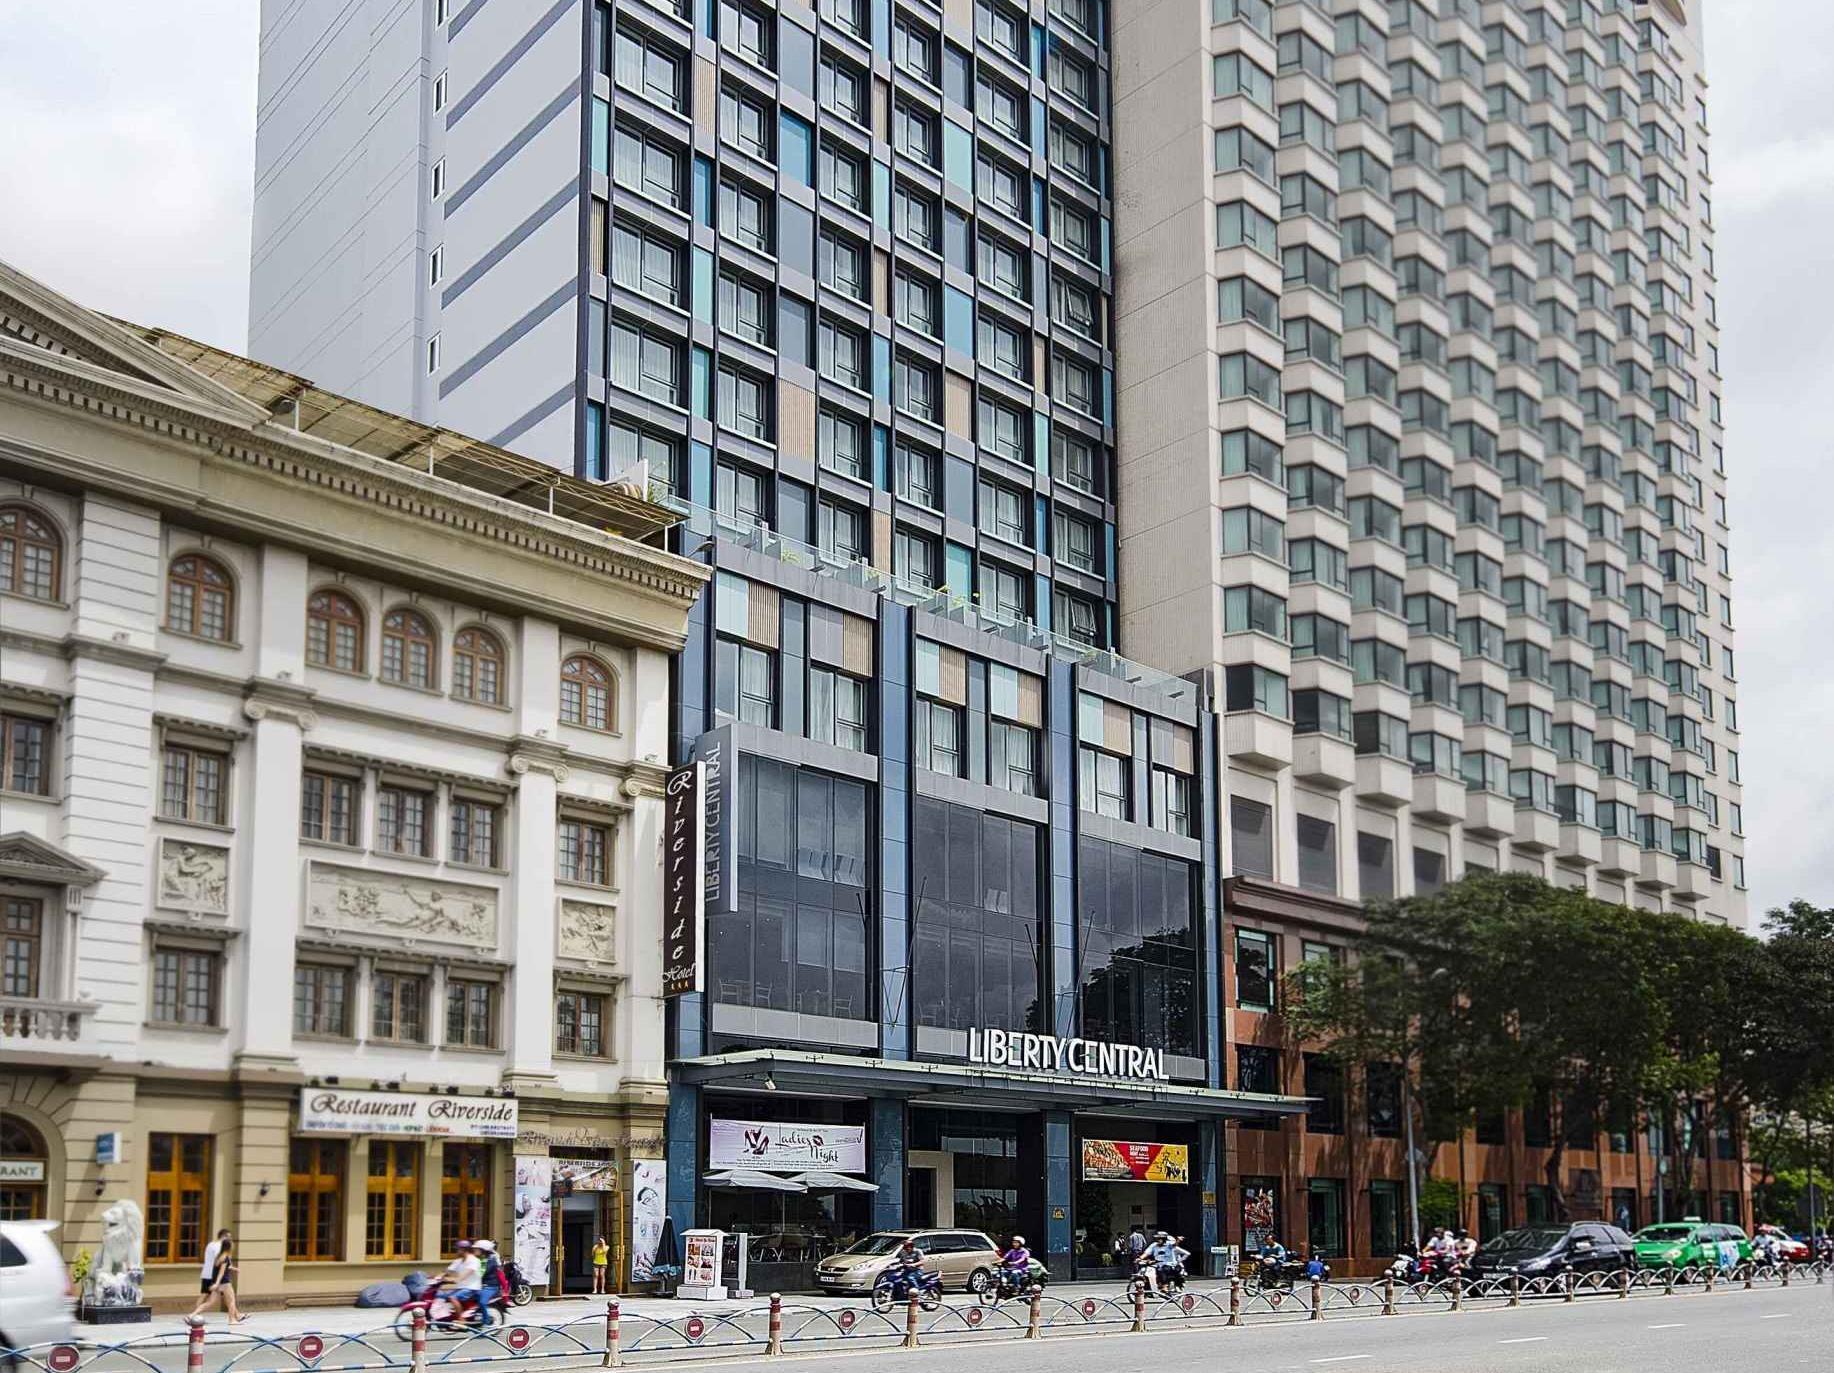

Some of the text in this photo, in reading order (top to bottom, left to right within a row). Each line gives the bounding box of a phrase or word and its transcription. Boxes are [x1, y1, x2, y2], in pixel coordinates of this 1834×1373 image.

[666, 770, 693, 960] Riverside
[662, 962, 697, 983] Hotel
[310, 1092, 513, 1122] Restaurant Riverside
[775, 1124, 813, 1149] Ladies
[810, 1145, 840, 1163] Night
